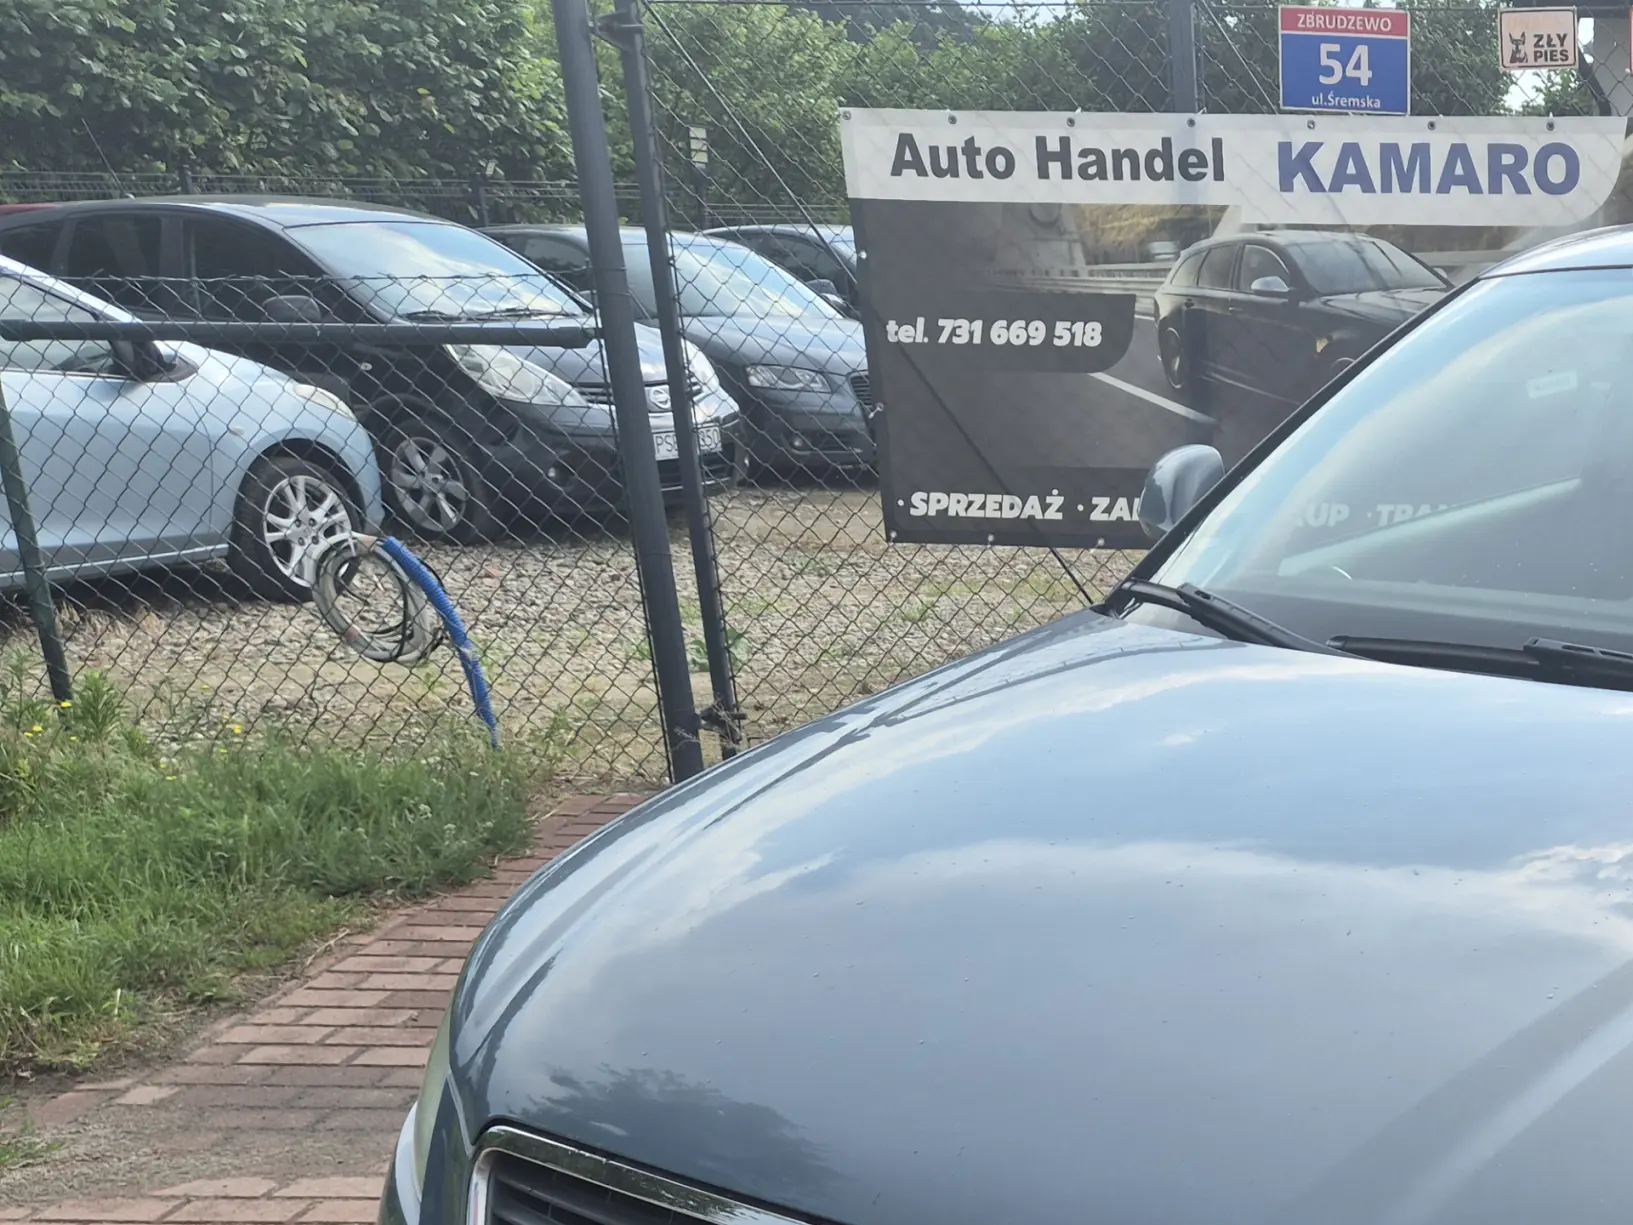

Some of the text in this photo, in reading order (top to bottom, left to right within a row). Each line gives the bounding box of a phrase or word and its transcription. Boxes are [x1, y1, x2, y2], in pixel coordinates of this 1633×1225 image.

[1297, 13, 1392, 32] ZBRUDZEWO
[1533, 33, 1568, 48] ZŁY
[1533, 49, 1570, 63] PIES
[1319, 43, 1373, 87] 54
[890, 132, 1581, 196] Auto Handel KAMARO
[886, 316, 1103, 347] tel. 731 669 518
[909, 489, 1065, 520] SPRZEDAŻ
[1089, 496, 1141, 521] ZA
